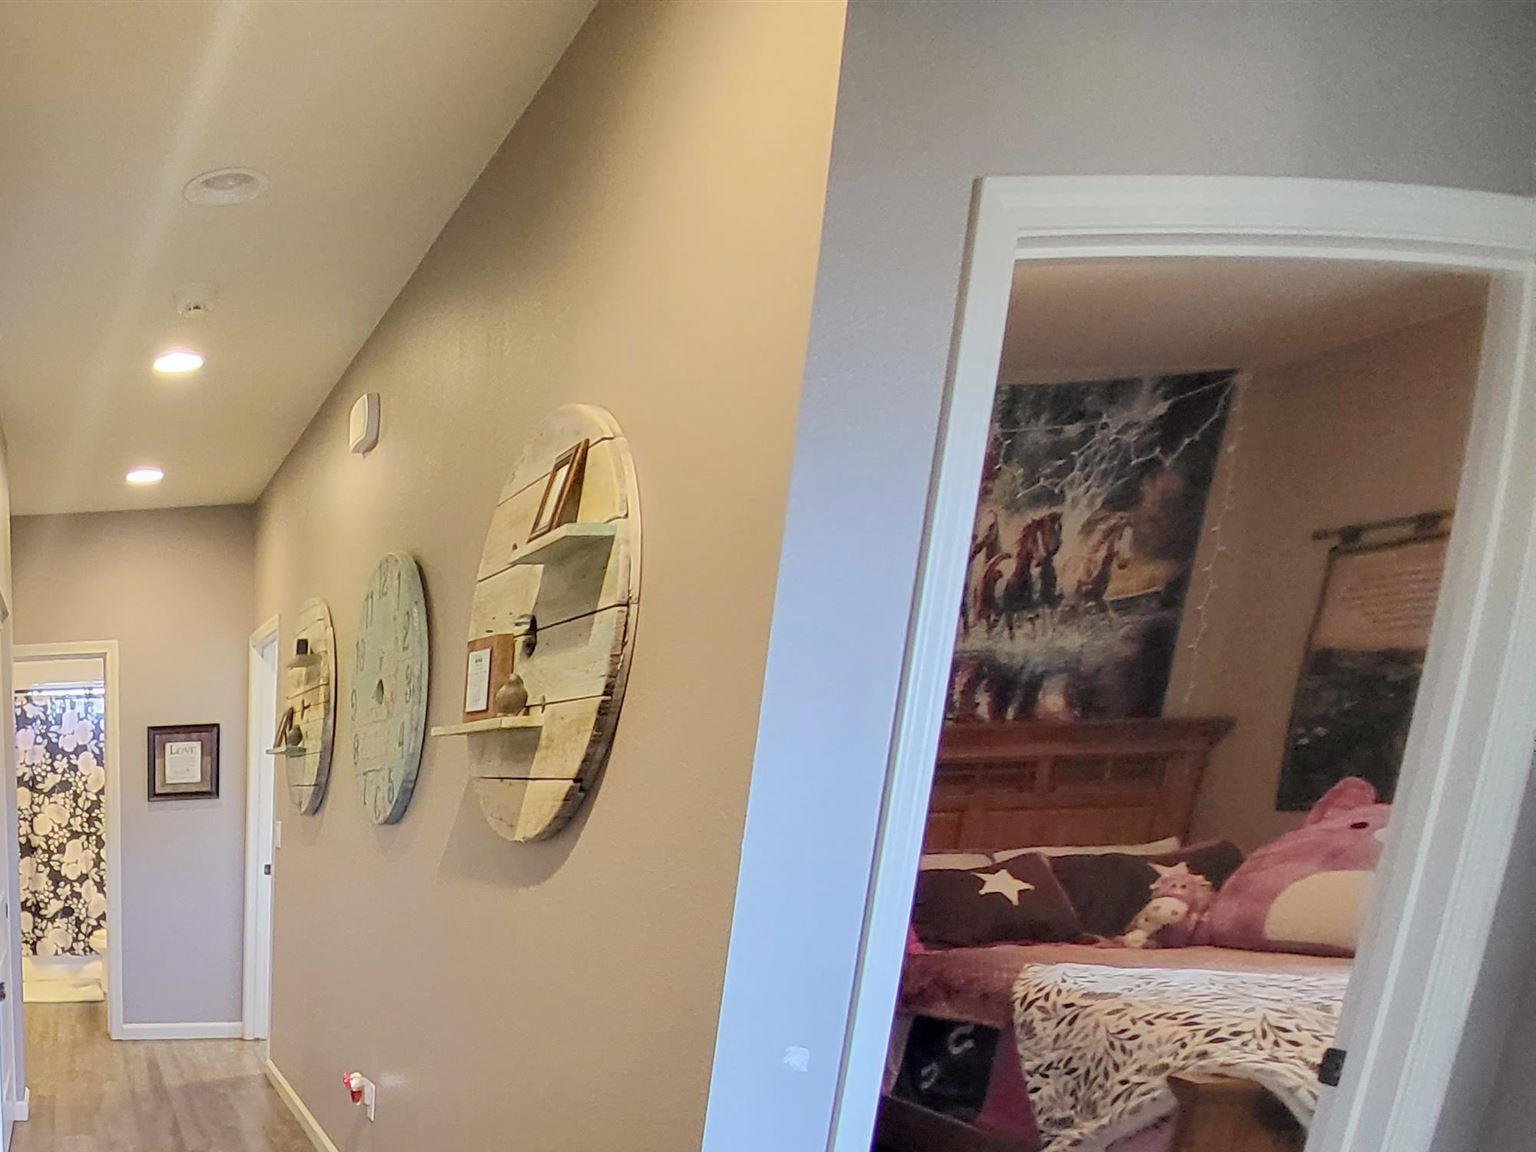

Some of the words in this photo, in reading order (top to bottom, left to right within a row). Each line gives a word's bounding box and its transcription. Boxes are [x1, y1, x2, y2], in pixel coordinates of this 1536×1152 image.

[378, 557, 390, 600] 12
[364, 590, 374, 630] 11
[402, 609, 410, 653] 2
